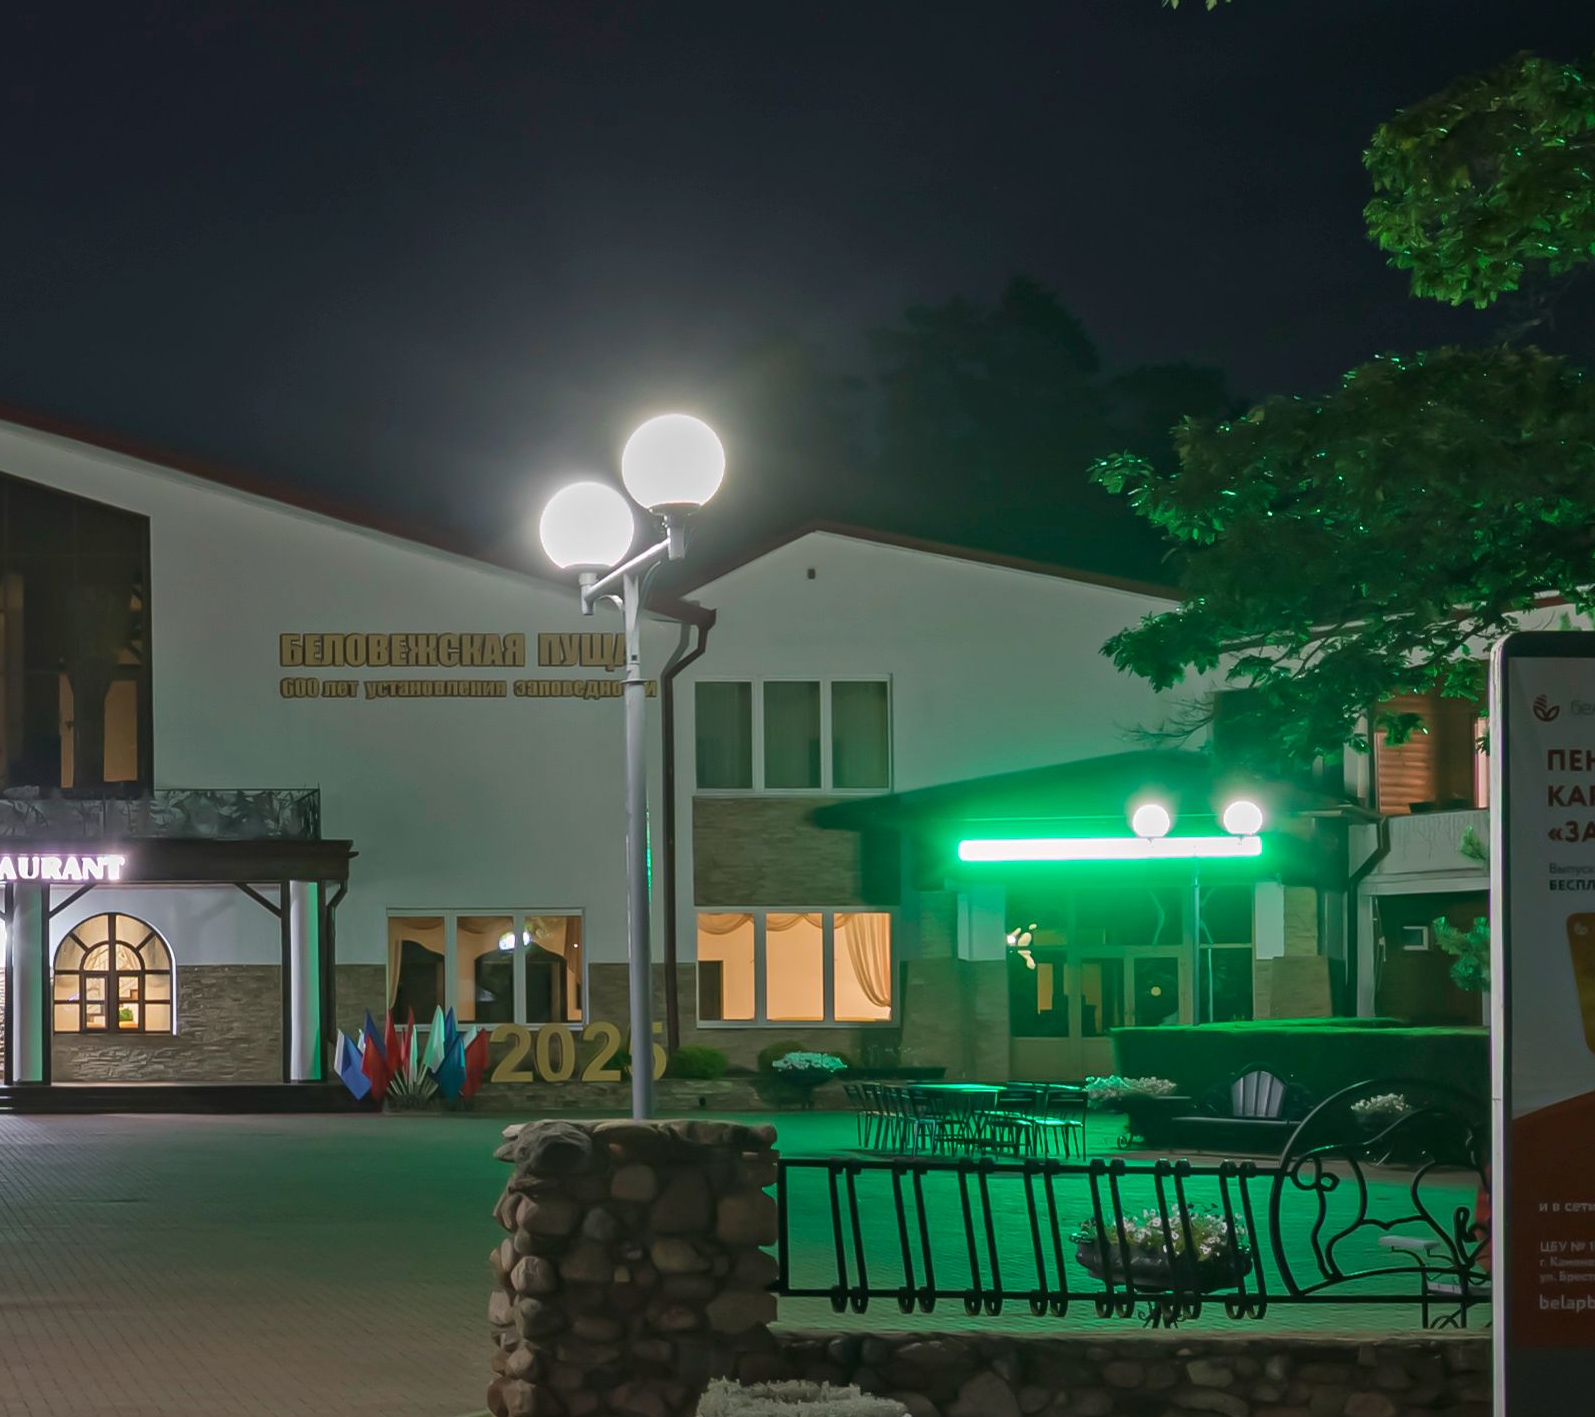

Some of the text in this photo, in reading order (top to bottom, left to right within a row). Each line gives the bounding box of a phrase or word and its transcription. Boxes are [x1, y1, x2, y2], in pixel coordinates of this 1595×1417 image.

[280, 633, 525, 667] БЕЛОВЕЖСКАЯ
[280, 678, 657, 700] 600 лет установления заповеднои
[1549, 863, 1595, 876] Выпуск
[1539, 1202, 1548, 1212] и
[1552, 1202, 1560, 1212] в
